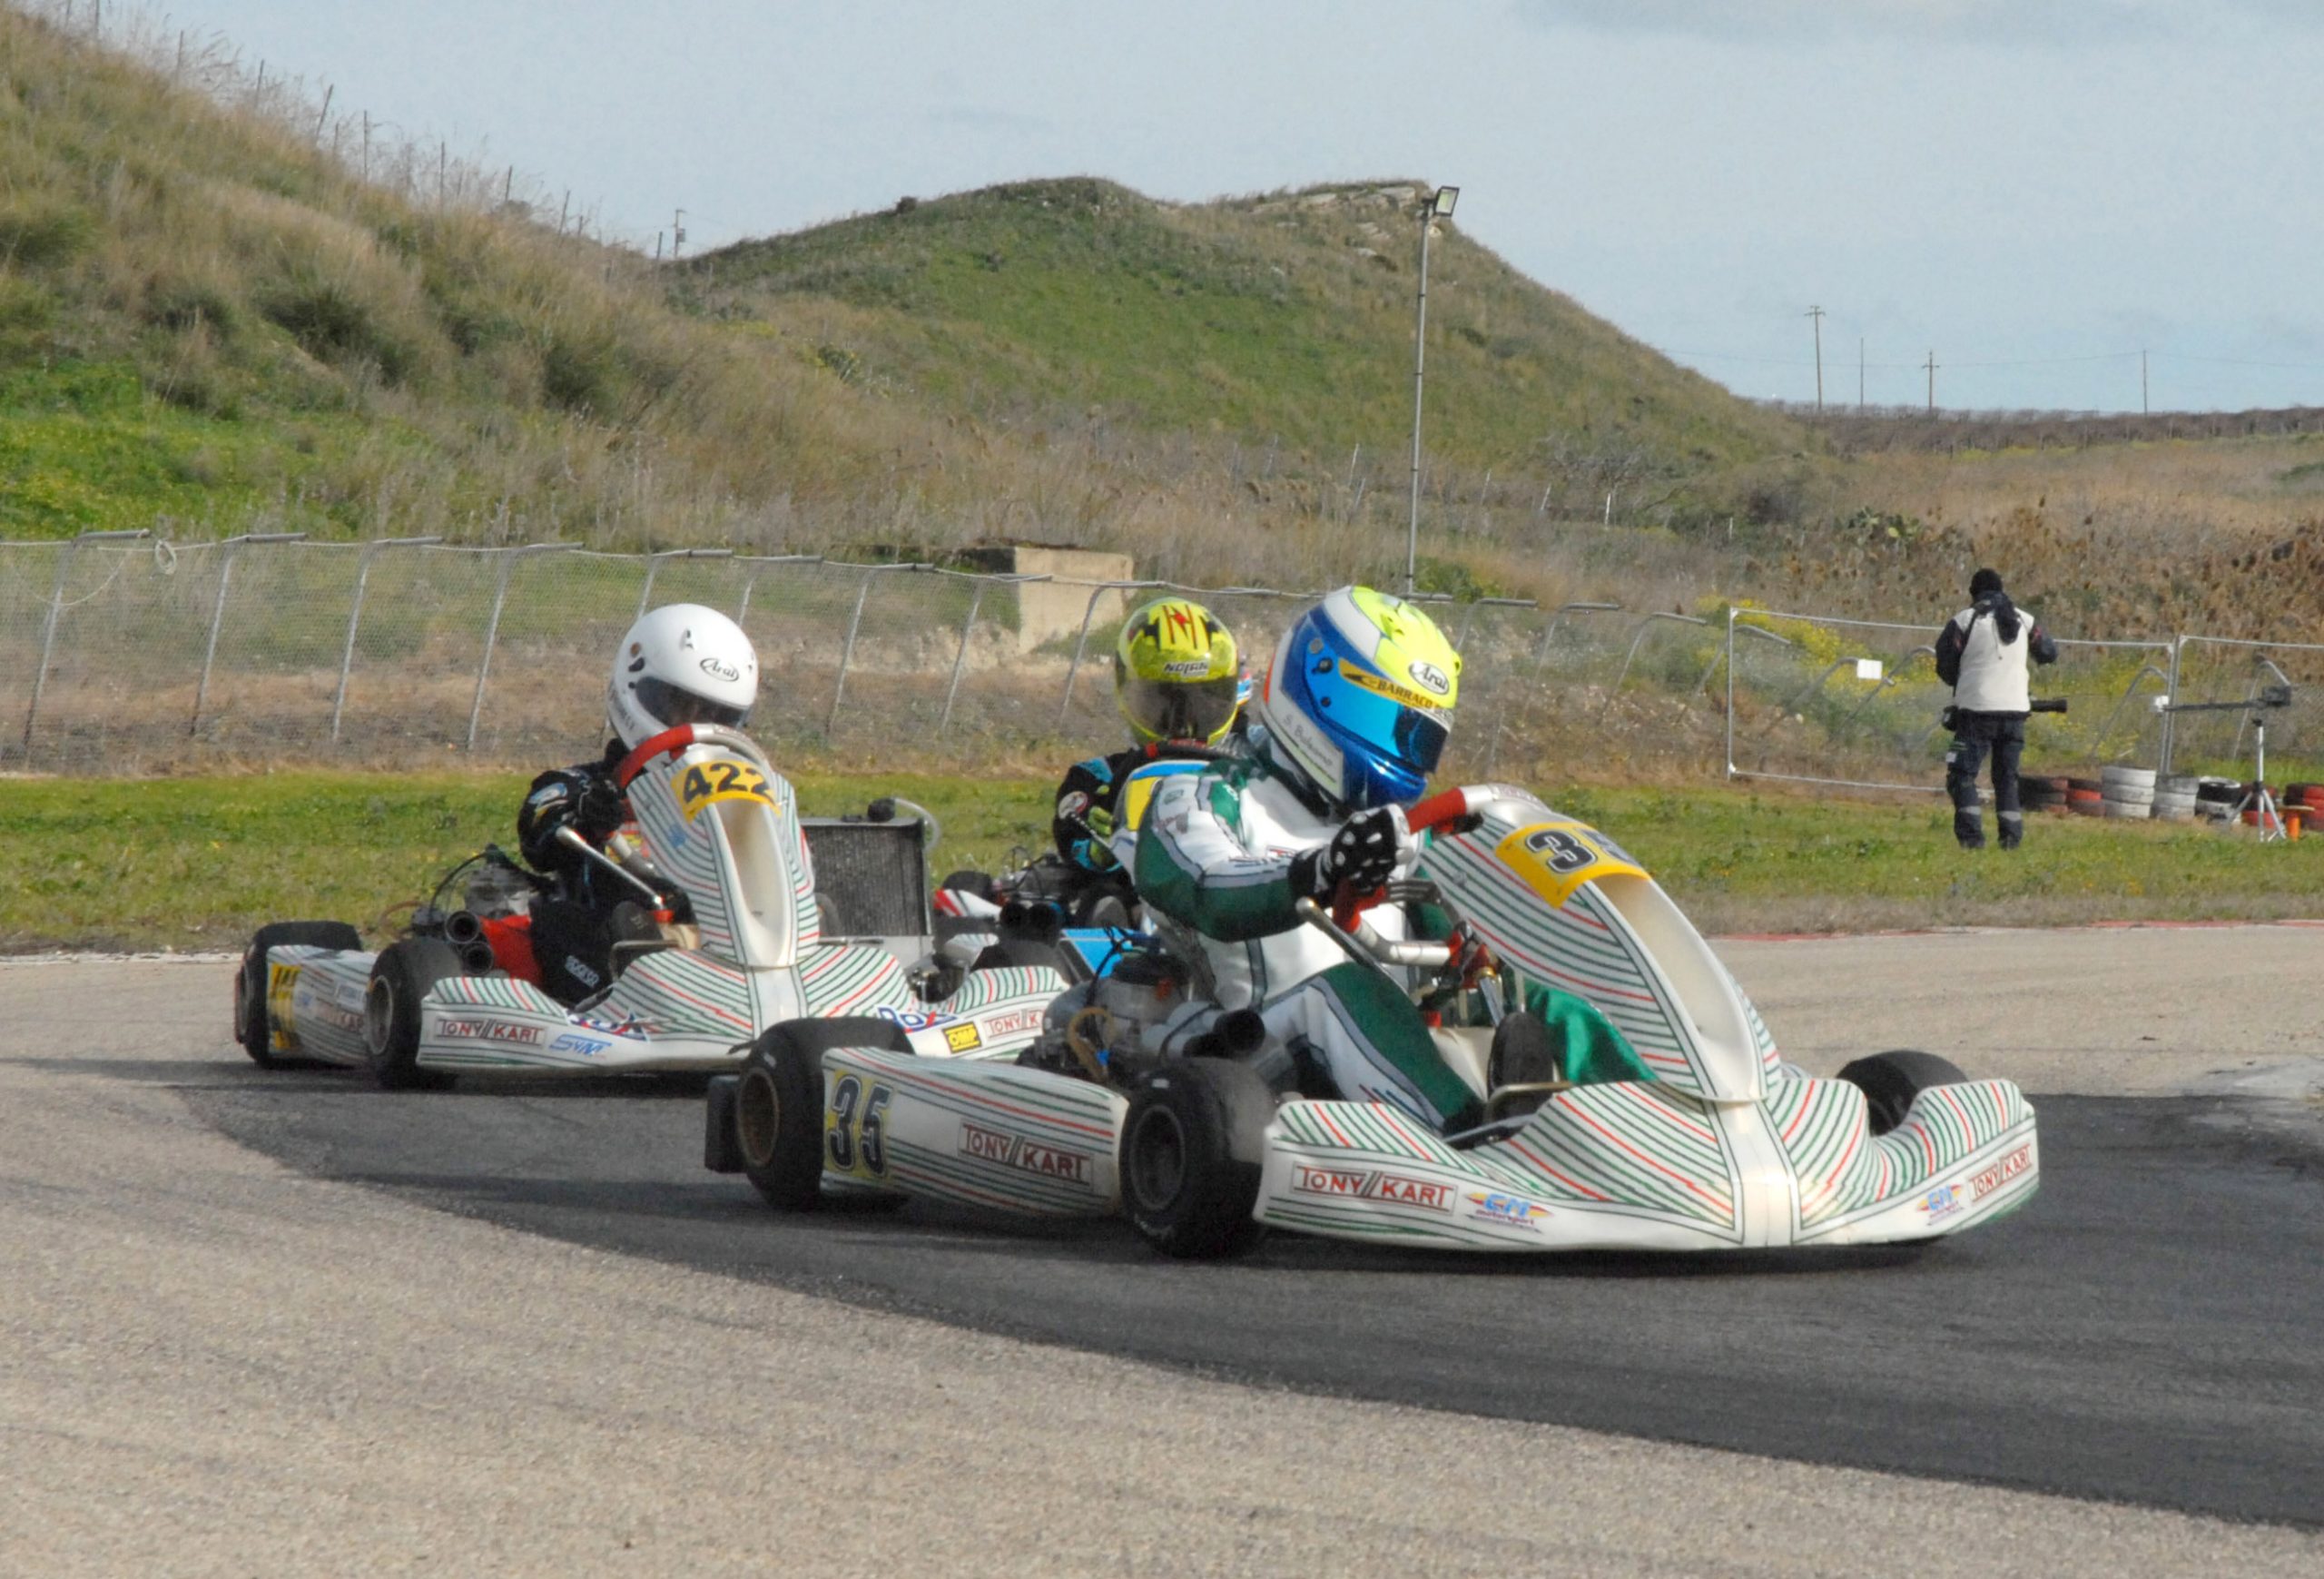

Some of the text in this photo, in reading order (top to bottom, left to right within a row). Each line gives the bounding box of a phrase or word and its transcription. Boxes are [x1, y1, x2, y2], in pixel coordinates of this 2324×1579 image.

[705, 659, 736, 679] Arai
[1415, 666, 1447, 690] Arai
[683, 762, 775, 804] 422
[439, 1020, 542, 1044] TONY KART
[988, 1014, 1021, 1034] TONY
[828, 1073, 893, 1178] 35
[964, 1124, 1088, 1180] TONY KART
[1300, 1166, 1452, 1207] TONY KART
[1970, 1164, 2000, 1198] TONY
